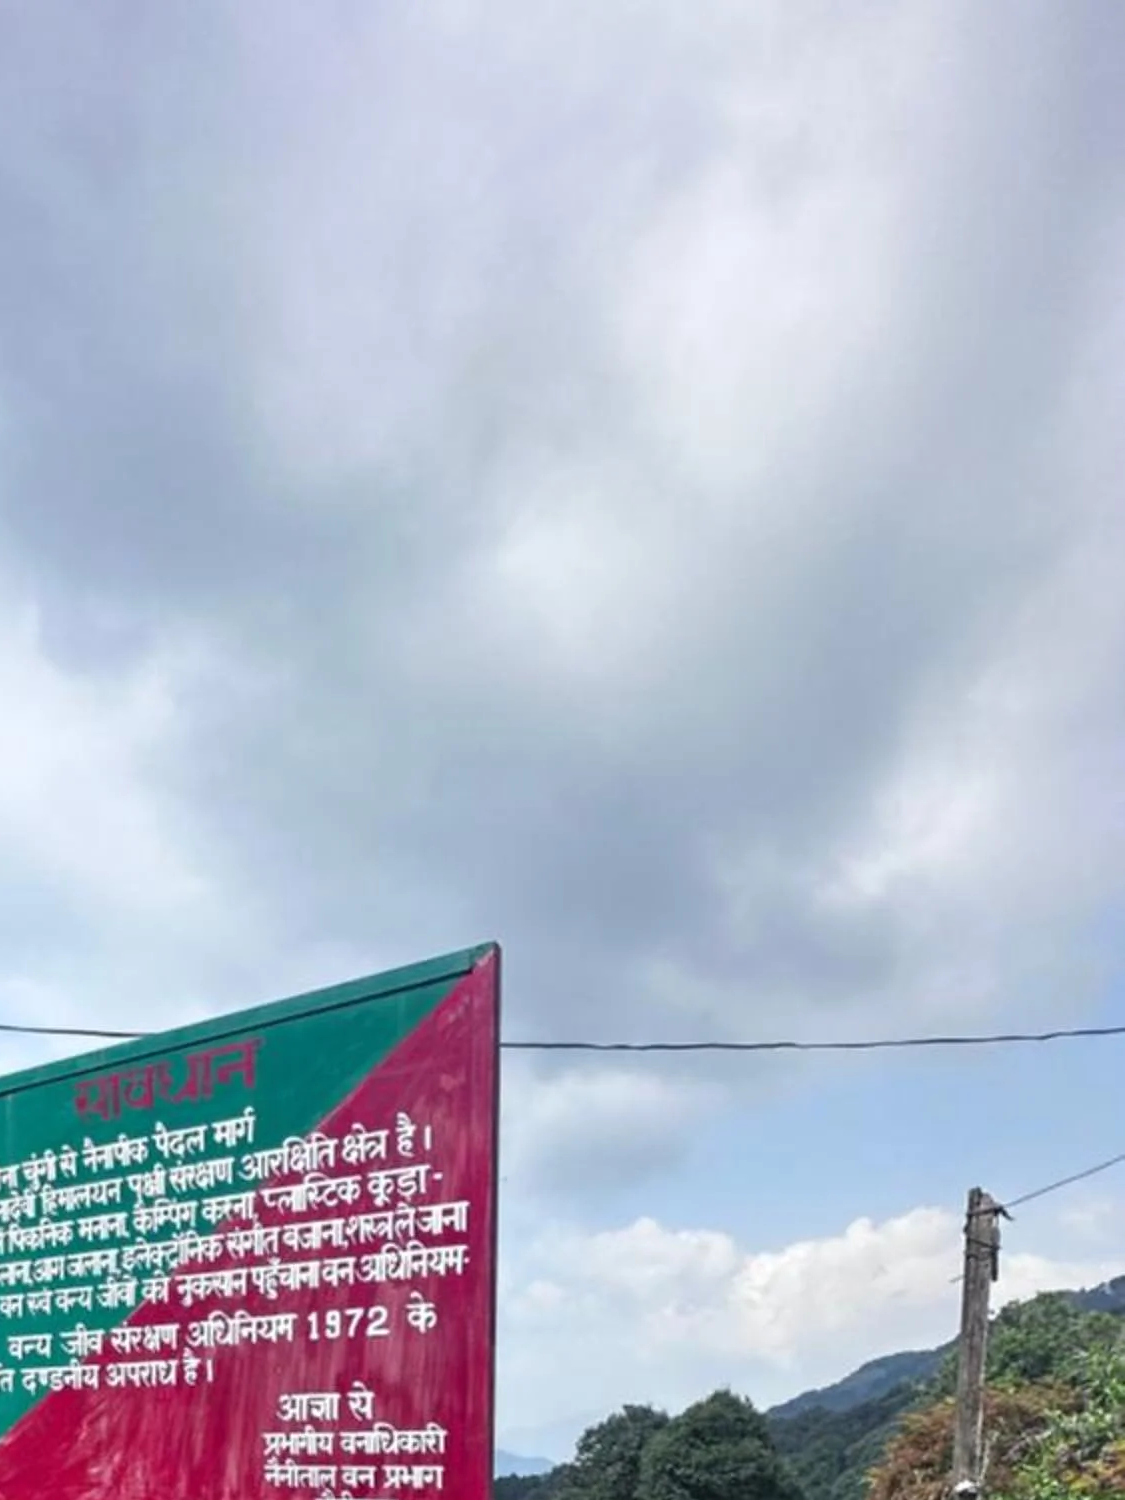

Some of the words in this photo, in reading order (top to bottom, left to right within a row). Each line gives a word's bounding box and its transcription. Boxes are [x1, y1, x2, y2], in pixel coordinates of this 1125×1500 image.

[74, 1038, 264, 1121] सावधान
[58, 1144, 78, 1177] से
[151, 1121, 208, 1158] पैदल
[212, 1106, 256, 1148] मार्ग
[169, 1156, 234, 1193] संरक्षण
[342, 1122, 390, 1166] क्षेत्र
[6, 1217, 75, 1253] पिकनिक
[260, 1172, 363, 1215] प्लास्टिक
[225, 1221, 280, 1259] संगीत
[416, 1201, 470, 1235] जाना
[54, 1285, 93, 1310] वन्य
[141, 1271, 172, 1304] को
[175, 1268, 247, 1307] नुकसान
[321, 1255, 356, 1287] वन
[7, 1332, 53, 1360] वन्य
[60, 1322, 105, 1357] जीव
[110, 1320, 180, 1355] संरक्षण
[186, 1308, 299, 1348] अधिनियम
[306, 1304, 390, 1341] 1972
[405, 1290, 439, 1333] के
[21, 1358, 101, 1397] दण्डनीय
[106, 1359, 178, 1388] अपराध
[276, 1391, 341, 1422] आज्ञा
[347, 1380, 375, 1421] से
[262, 1424, 335, 1456] प्रभागीय
[339, 1421, 448, 1454] वनाधिकारी
[263, 1455, 338, 1489] नैनीताल
[340, 1464, 376, 1489] वन
[381, 1464, 445, 1490] प्रभाग
